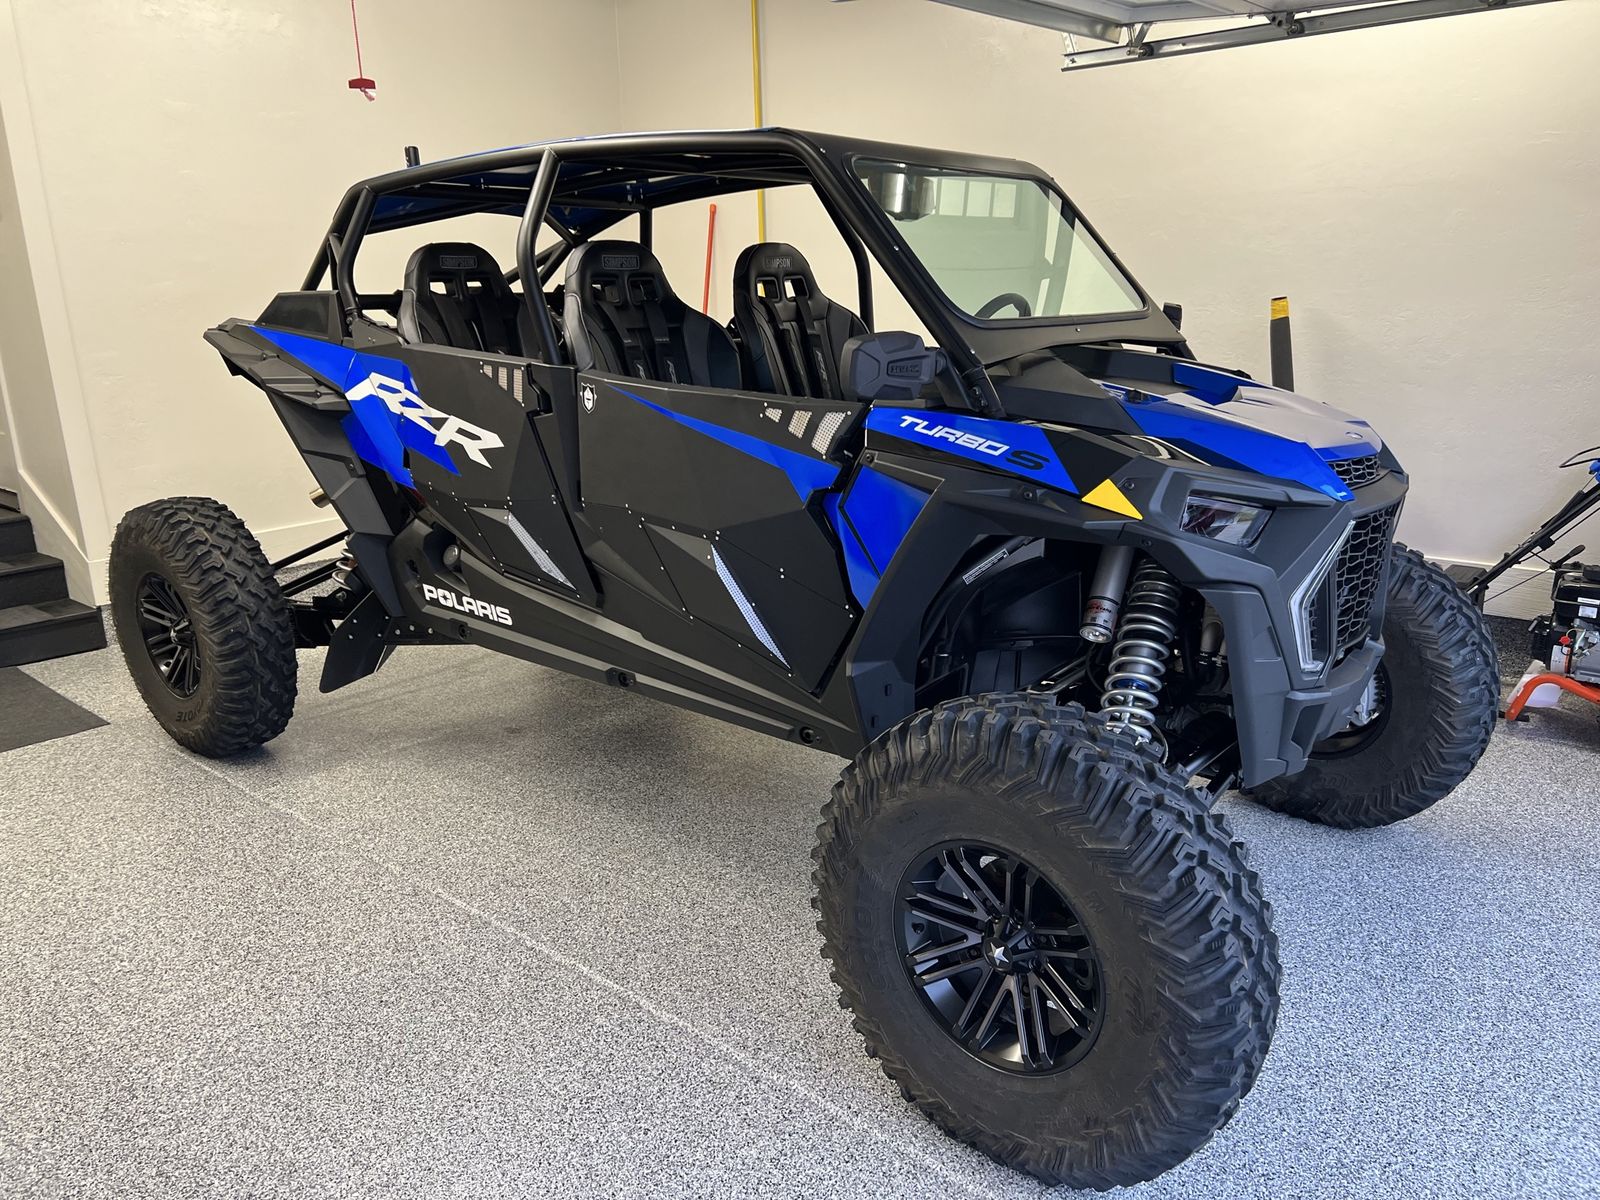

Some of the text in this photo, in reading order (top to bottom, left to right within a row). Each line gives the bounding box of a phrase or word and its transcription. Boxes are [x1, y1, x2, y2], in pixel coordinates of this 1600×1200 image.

[345, 372, 505, 469] RZR
[899, 415, 1050, 471] TURBO S
[422, 583, 513, 626] POLARIS
